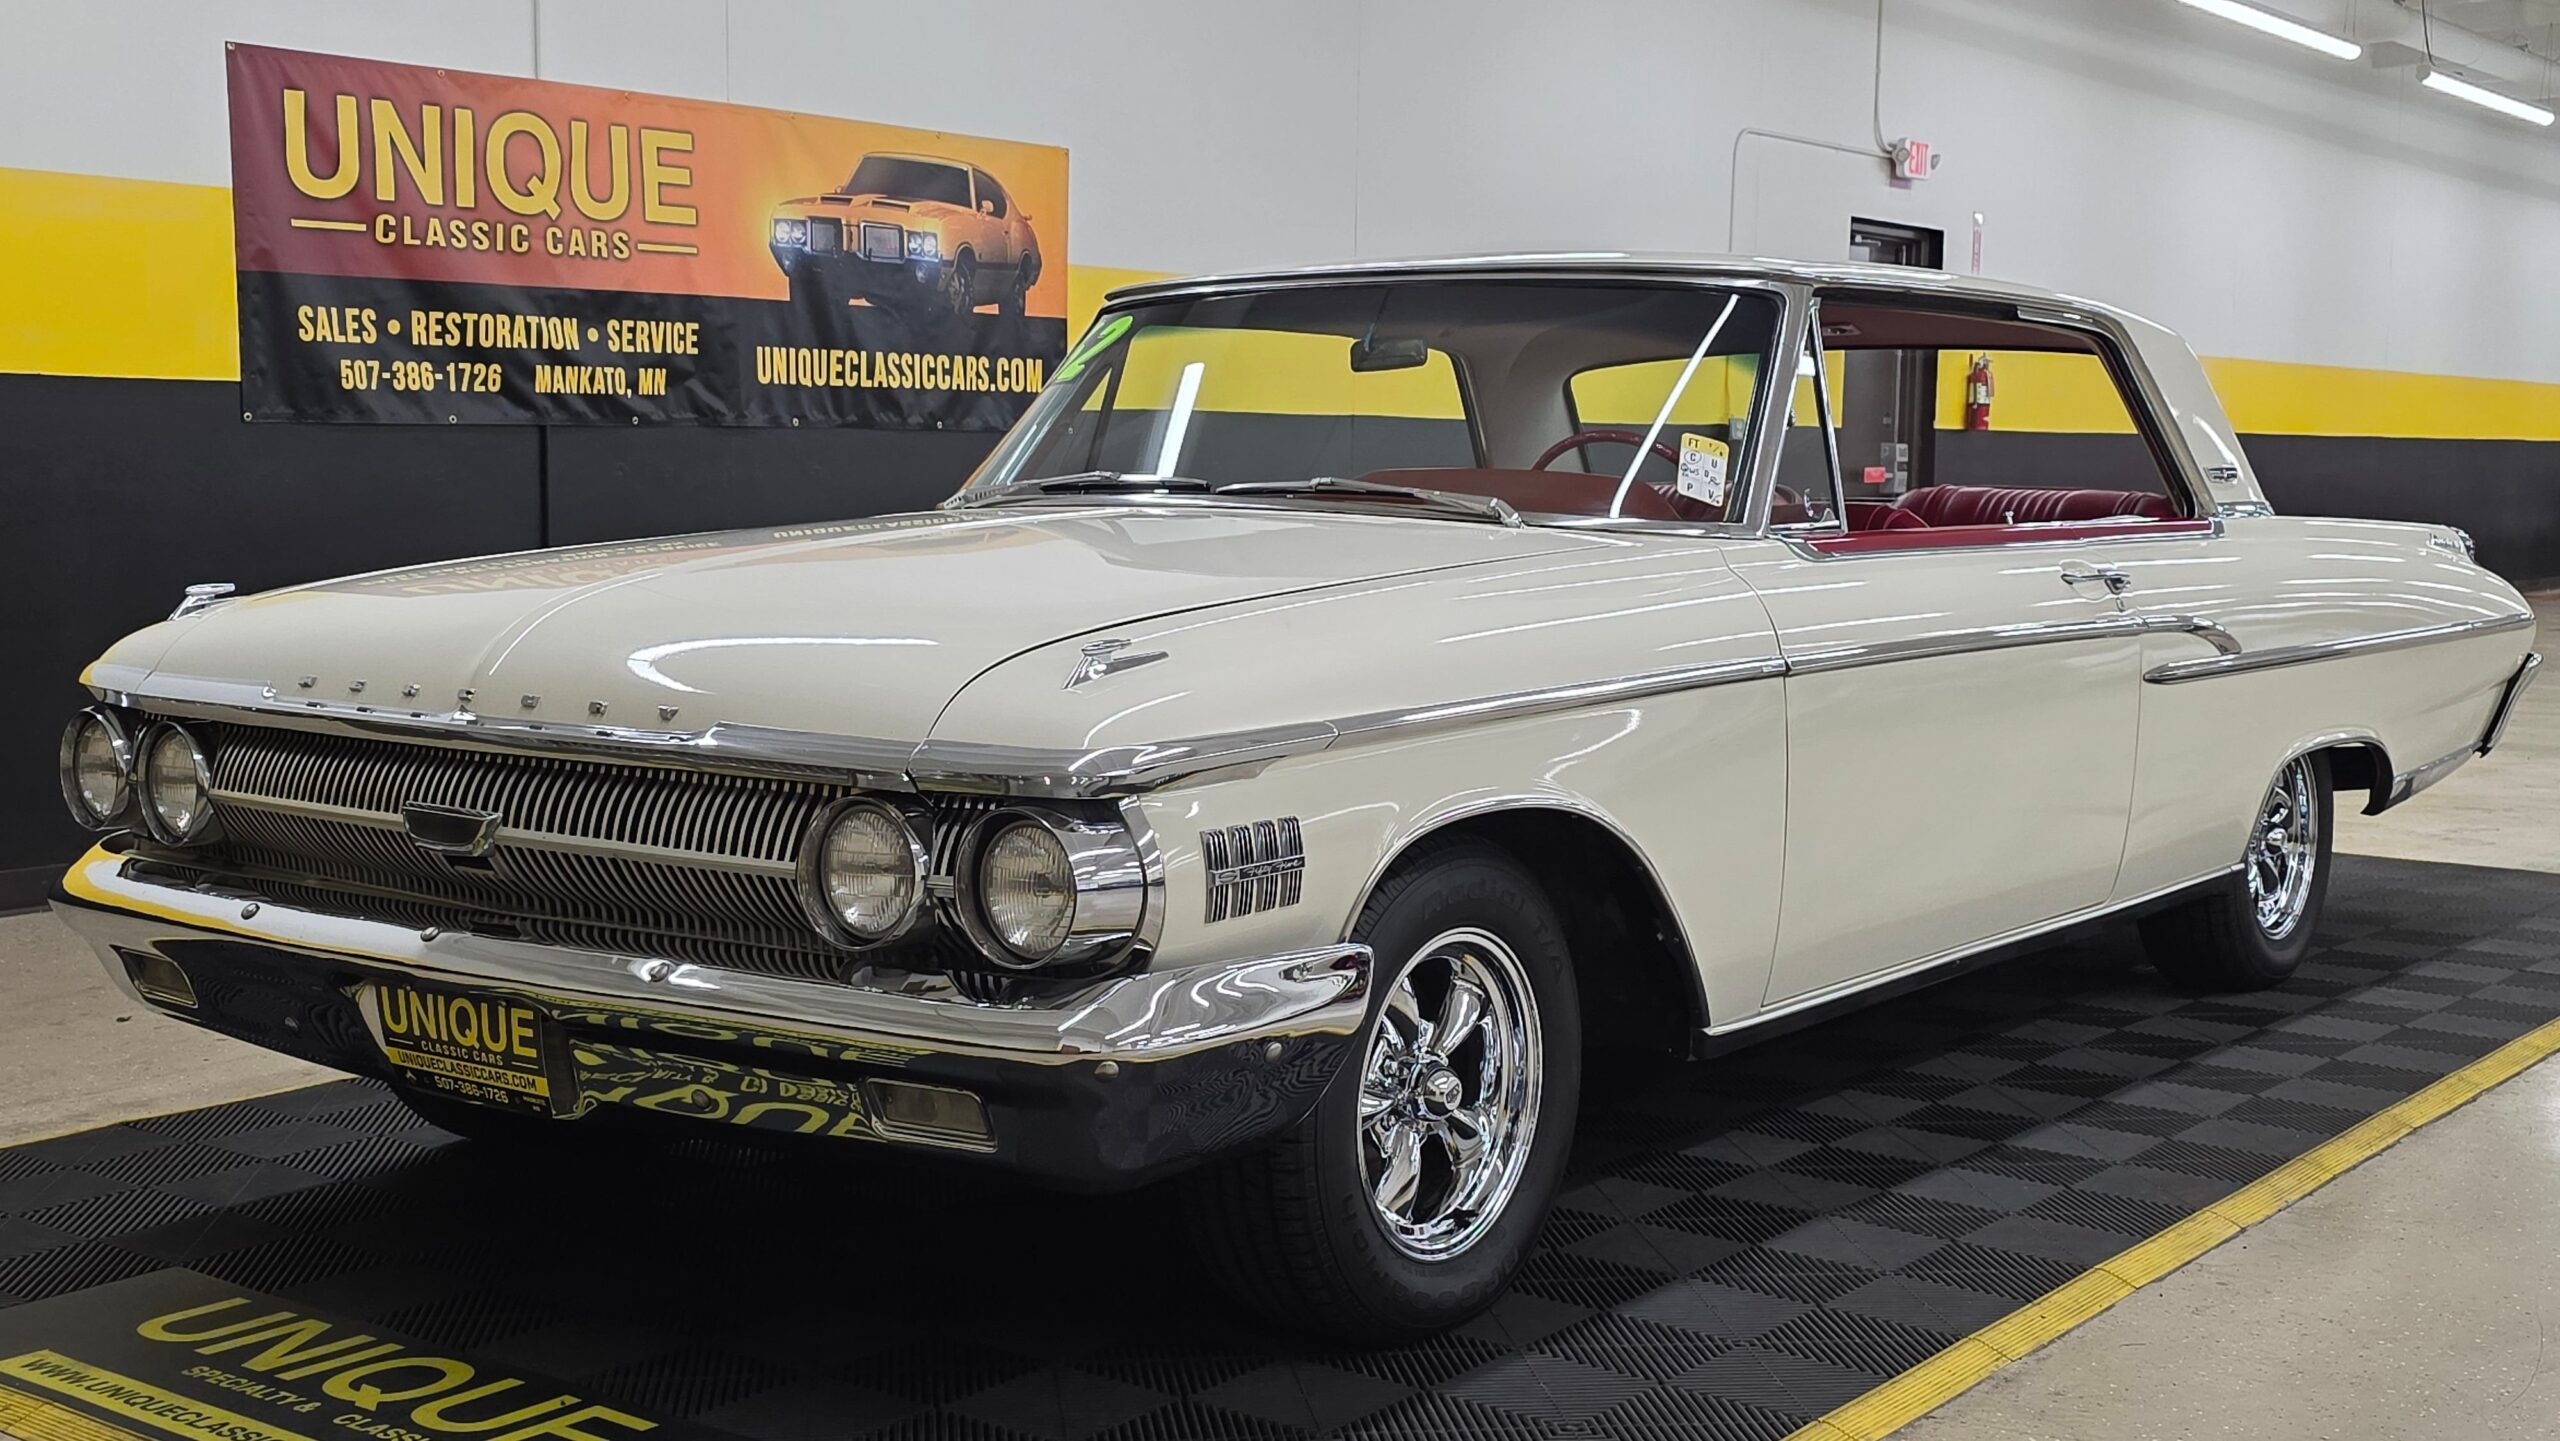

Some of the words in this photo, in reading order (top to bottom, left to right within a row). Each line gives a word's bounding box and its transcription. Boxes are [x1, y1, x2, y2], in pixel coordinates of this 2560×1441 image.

[283, 88, 698, 226] UNIQUE
[374, 213, 531, 253] CLASSIC
[546, 226, 631, 260] CARS
[298, 304, 377, 344] SALES
[411, 309, 580, 351] RESTORATION
[606, 318, 699, 355] SERVICE
[340, 359, 502, 393] 507-386-1726
[534, 364, 632, 399] MANKATO,
[638, 367, 667, 396] MN
[756, 345, 1044, 394] UNIQUECLASSICCARS.COM
[380, 985, 538, 1059] UNIQUE
[398, 1051, 538, 1092] UNIQUECLASSICCARS.COM
[420, 1040, 469, 1059] CLASSIC
[473, 1050, 504, 1066] CARS
[433, 1076, 509, 1104] 507-386-1726
[181, 1365, 298, 1407] SPECIALTY
[292, 1400, 323, 1414] &
